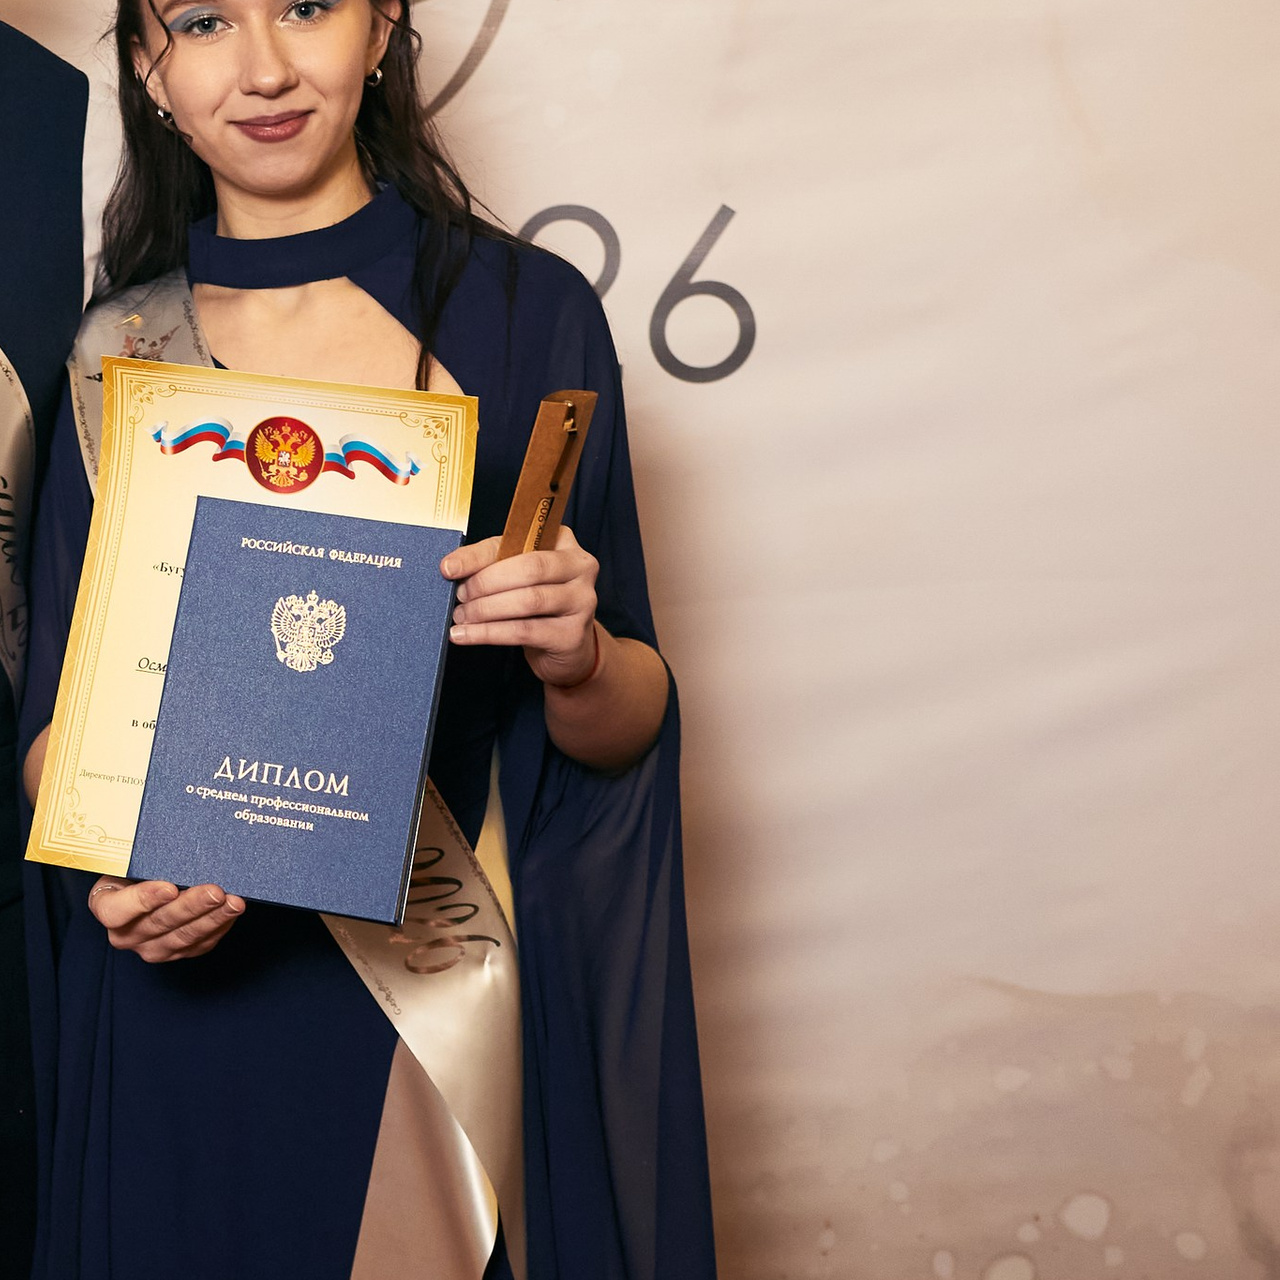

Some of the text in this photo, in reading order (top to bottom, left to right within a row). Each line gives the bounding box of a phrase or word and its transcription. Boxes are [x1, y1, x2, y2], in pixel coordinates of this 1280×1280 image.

[241, 537, 402, 569] РОССИЙСКАЯ ФЕДЕРАЦИЯ
[213, 756, 350, 797] ДИПЛОМ
[185, 784, 370, 822] о среднем профессиональном
[234, 809, 314, 831] образовании
